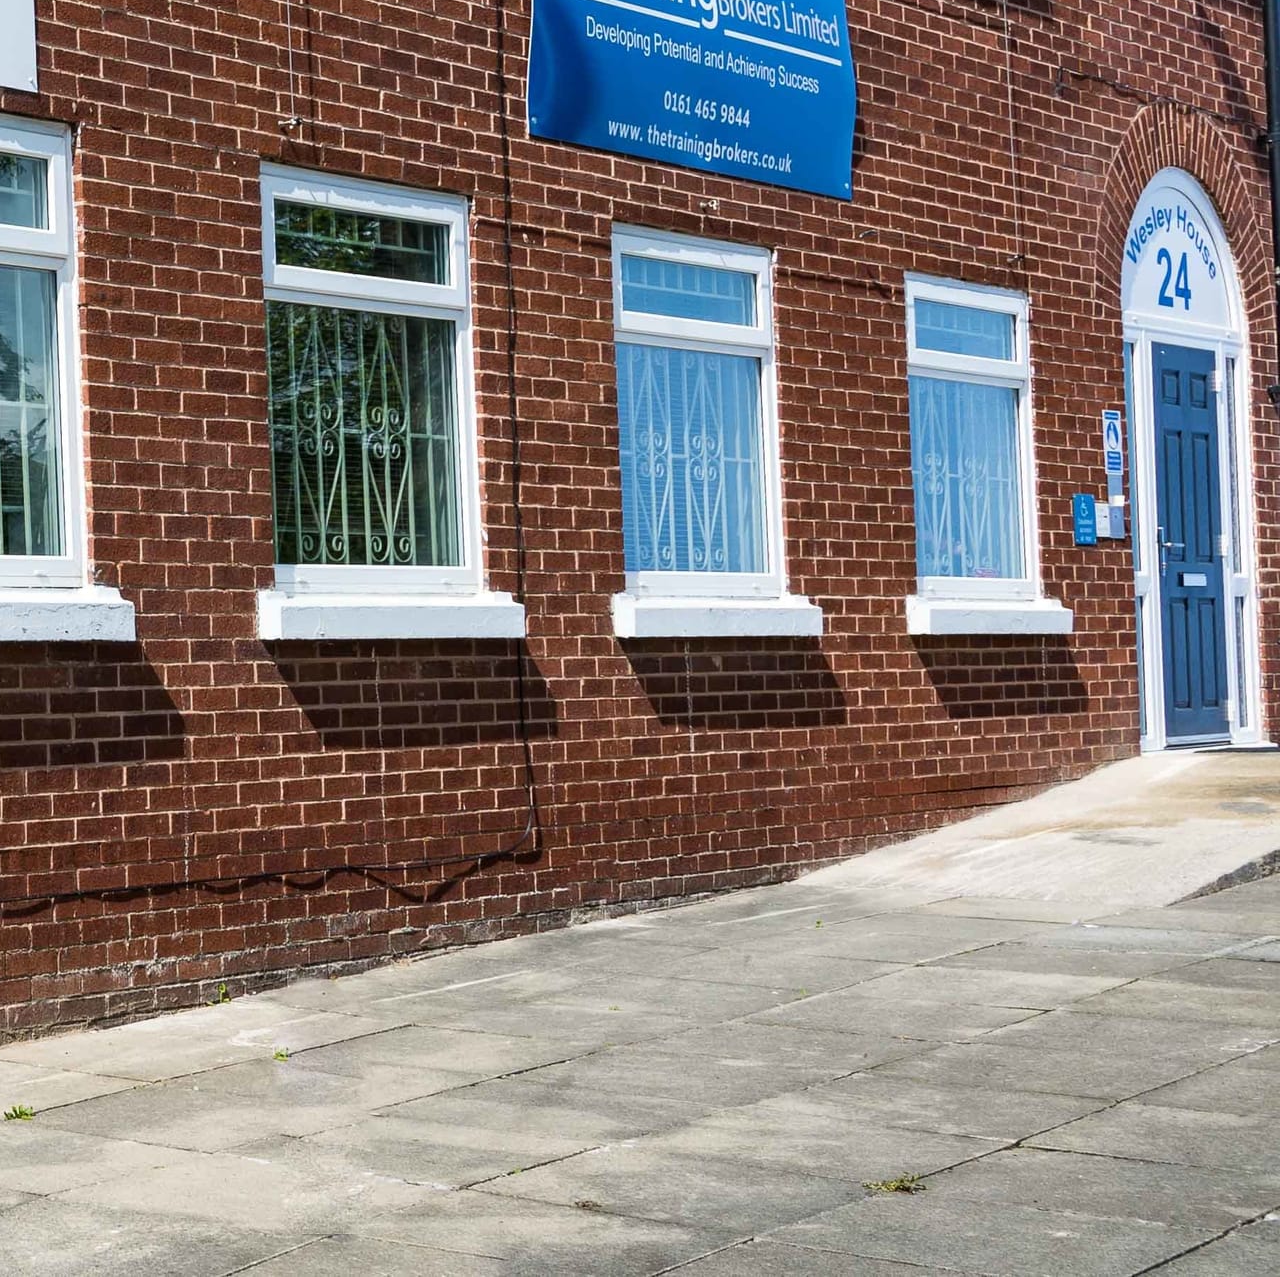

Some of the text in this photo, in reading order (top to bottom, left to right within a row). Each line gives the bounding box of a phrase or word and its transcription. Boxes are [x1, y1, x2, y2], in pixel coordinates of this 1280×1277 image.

[586, 16, 819, 94] Developing Potential and Achieving Success
[782, 1, 840, 47] Limited
[664, 90, 750, 128] 0161 465 9844
[1126, 205, 1216, 279] Wesley House
[1157, 248, 1191, 310] 24
